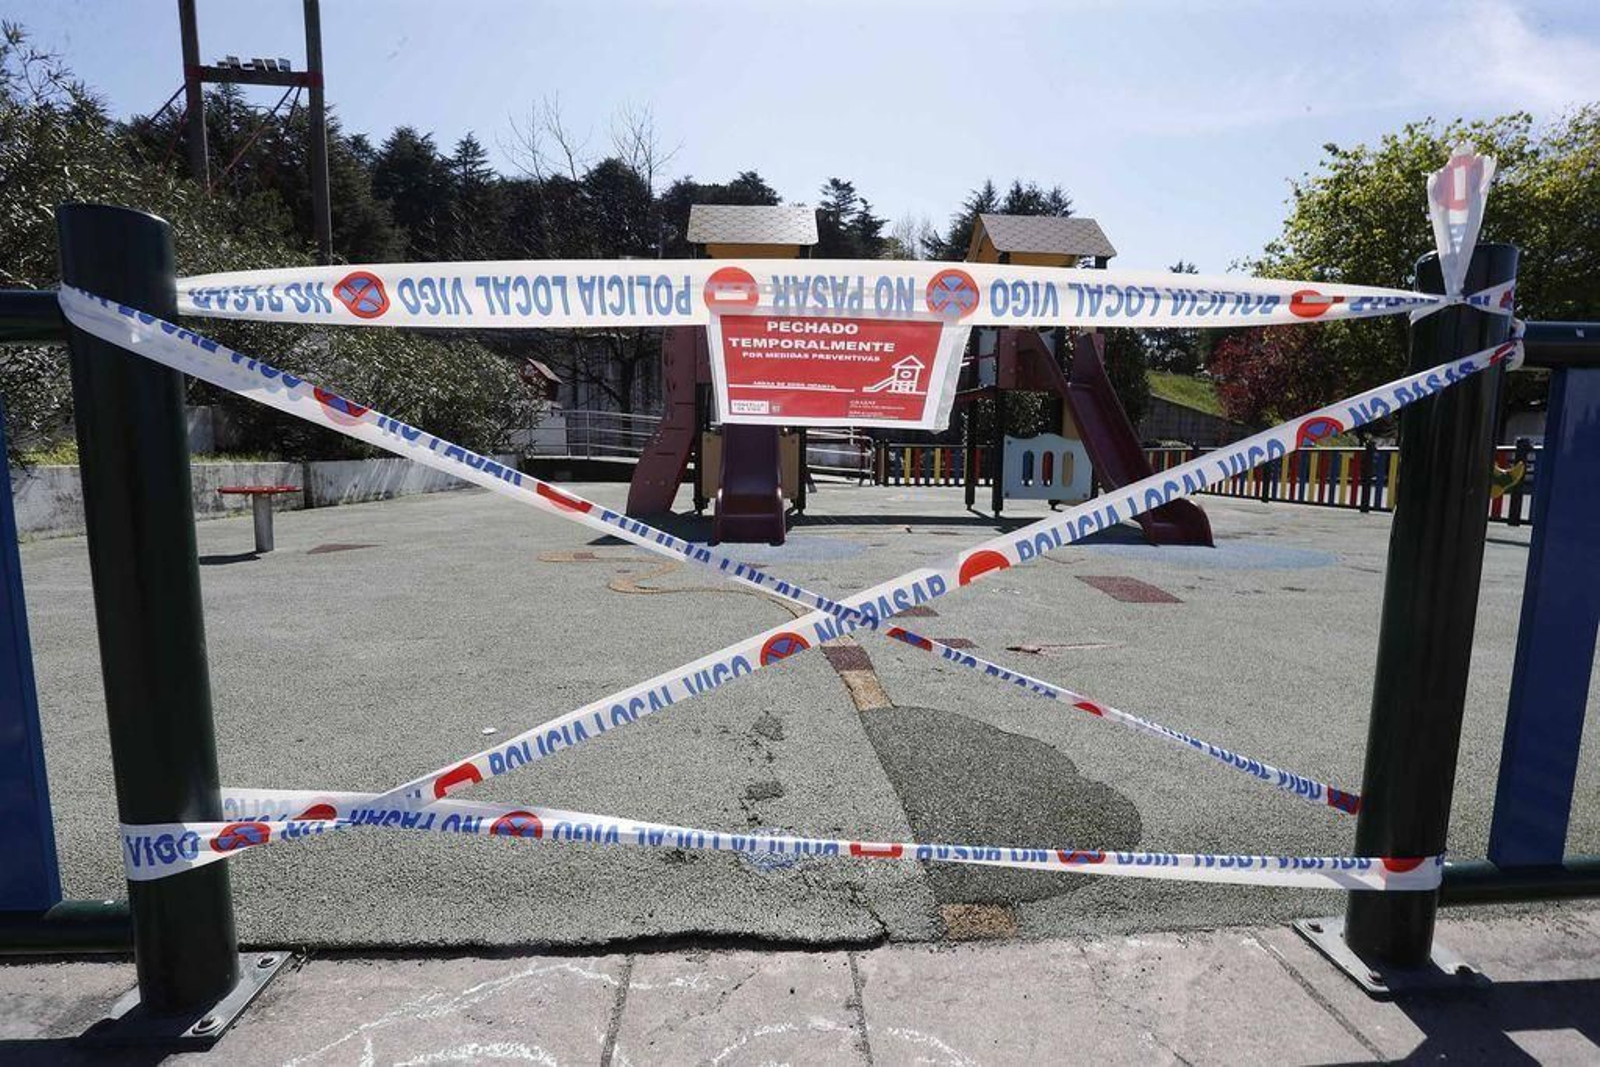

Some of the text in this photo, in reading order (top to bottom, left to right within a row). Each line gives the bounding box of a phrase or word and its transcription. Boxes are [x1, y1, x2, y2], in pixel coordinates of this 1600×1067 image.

[285, 282, 332, 314] NO
[397, 275, 692, 316] POLICIA LOCAL VIGO
[772, 276, 915, 317] NO PASAR
[990, 278, 1060, 318] VIGO
[1069, 283, 1163, 318] LOCAL
[728, 337, 896, 353] TEMPORALMENTE
[766, 321, 859, 335] PECHADO
[765, 352, 809, 360] MEDIDAS
[812, 354, 881, 363] PREVENTIVAS
[1347, 396, 1392, 428] NO
[1015, 503, 1121, 563] POLICIA
[125, 831, 201, 868] VIGO
